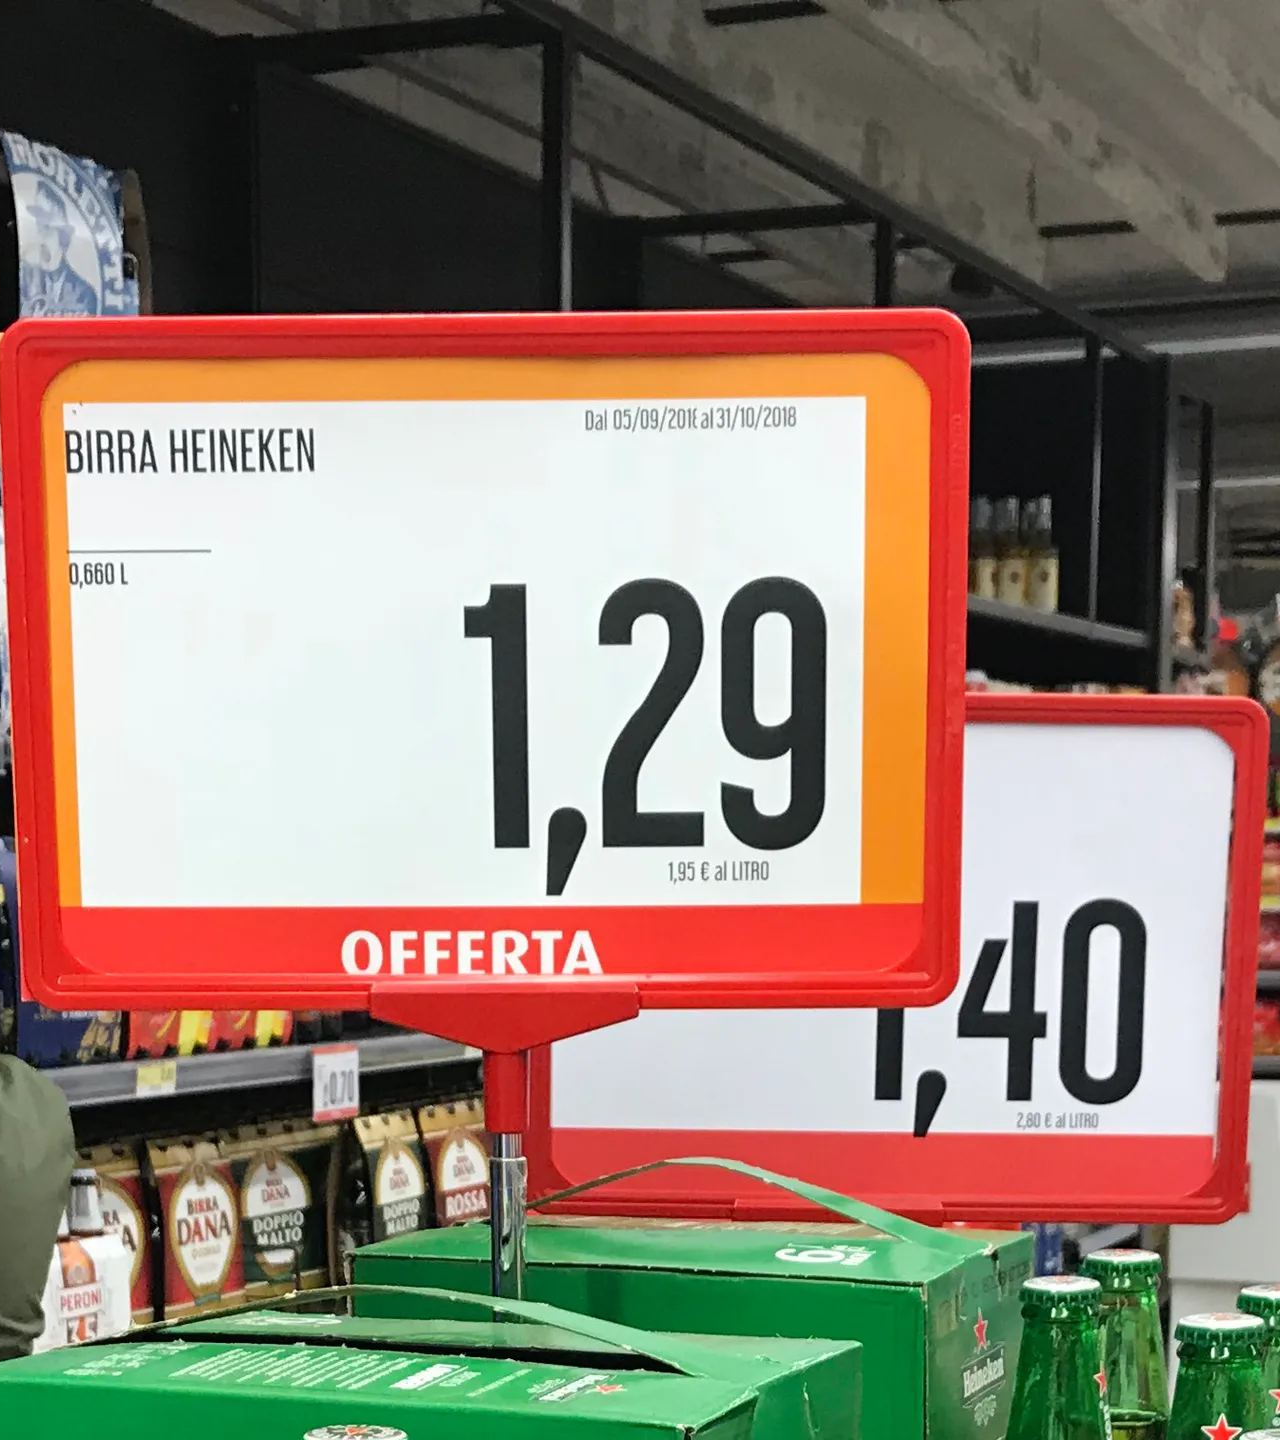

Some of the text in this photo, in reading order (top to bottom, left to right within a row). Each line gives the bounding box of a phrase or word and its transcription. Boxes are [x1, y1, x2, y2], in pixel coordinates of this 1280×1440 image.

[584, 408, 608, 431] Dal
[700, 407, 714, 430] al
[715, 404, 797, 431] 31/10/2018
[63, 427, 316, 475] BIRRA HEINEKEN
[68, 561, 128, 589] 0,660 L
[463, 575, 828, 897] 1,29
[667, 860, 770, 886] 1,95 € al LITRO
[340, 930, 604, 977] OFFERTA
[1015, 1112, 1041, 1131] 2,80
[1068, 1112, 1099, 1129] LITRO
[187, 1196, 219, 1216] BIRRA
[383, 1199, 420, 1220] DOPPIO
[445, 1189, 488, 1218] ROSSA
[177, 1210, 231, 1245] DANA
[252, 1210, 304, 1233] DOPPIO
[386, 1215, 419, 1236] MALTO
[257, 1227, 302, 1246] MALTO
[60, 1289, 102, 1311] PERONI
[963, 1357, 1005, 1398] Heineken
